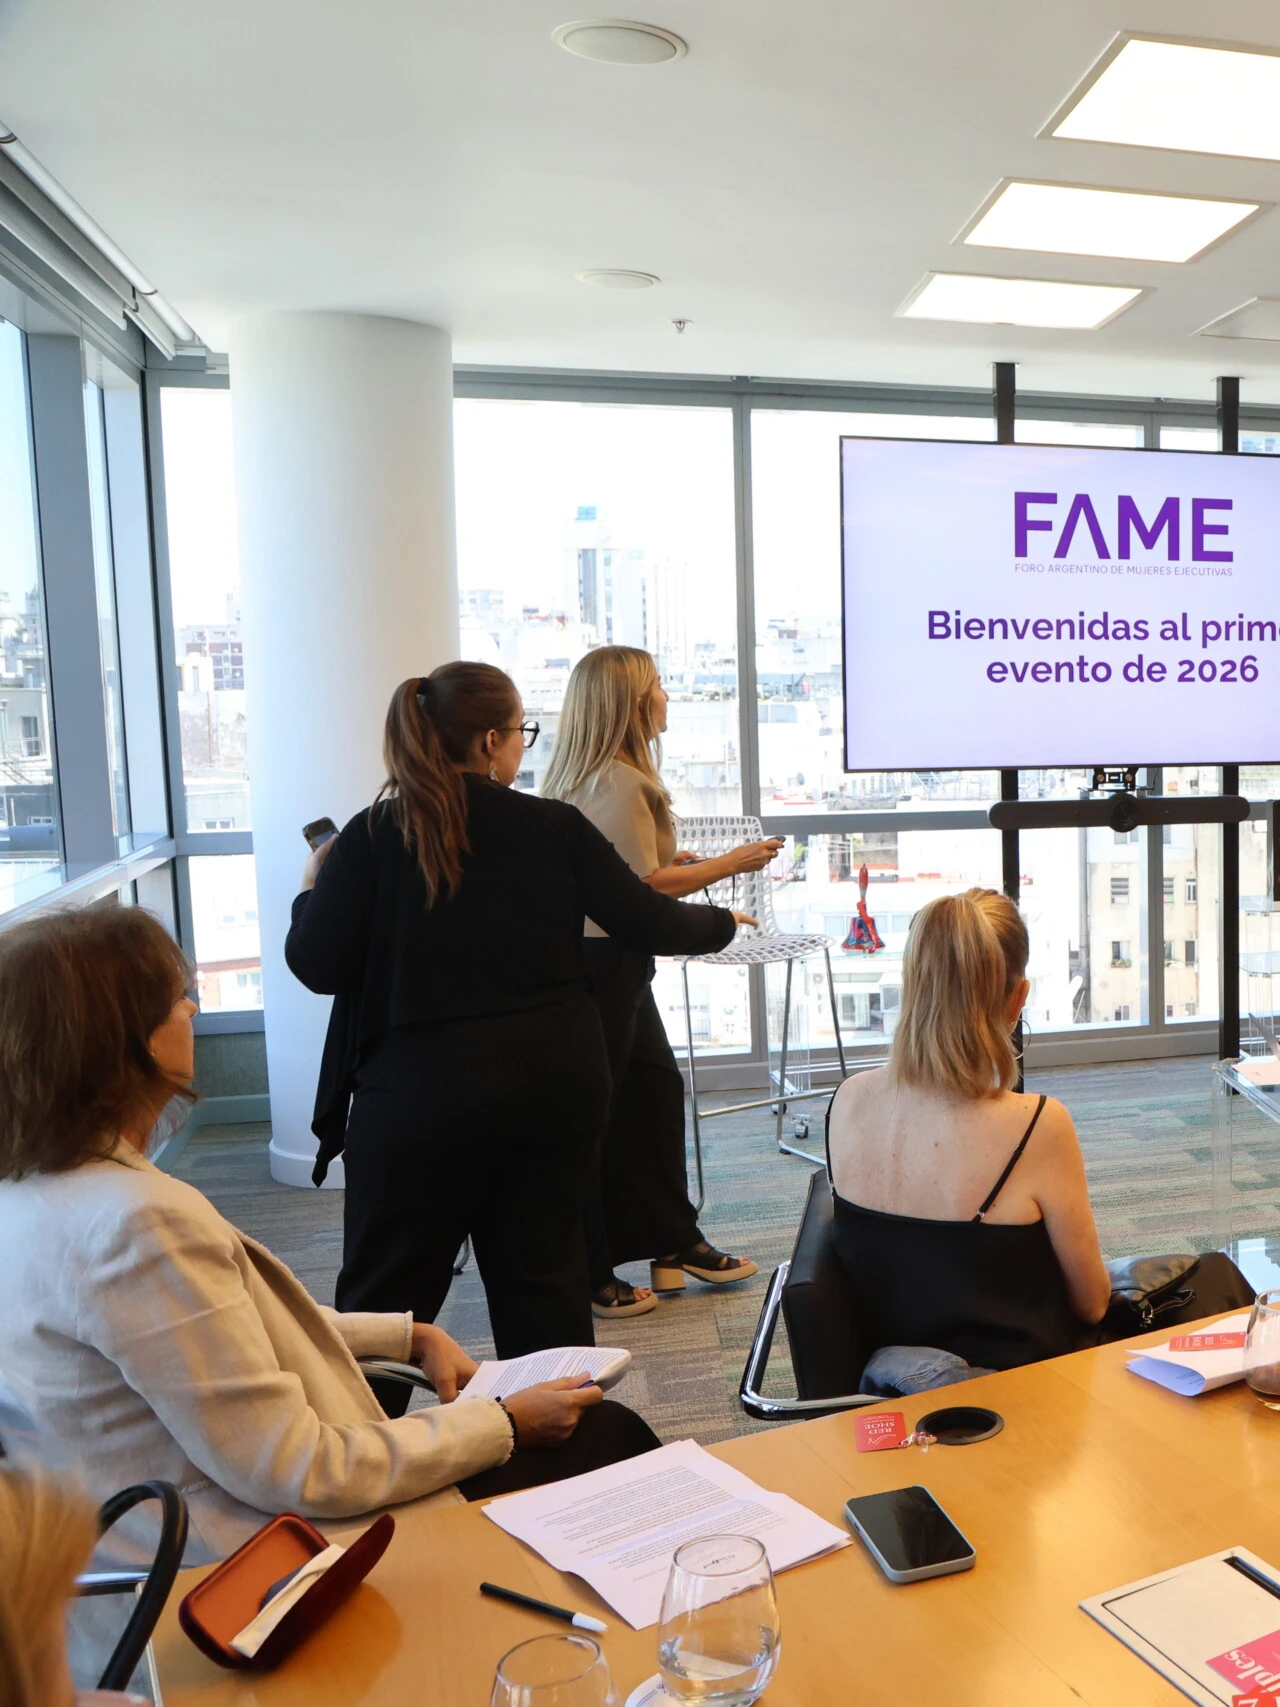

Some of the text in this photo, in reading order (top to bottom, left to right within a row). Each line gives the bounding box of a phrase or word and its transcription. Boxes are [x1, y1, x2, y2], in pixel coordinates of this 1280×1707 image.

[1014, 491, 1234, 563] FAME
[1014, 563, 1234, 577] FORO ARGENTINO DE MUJERES EJECUTIVAS
[927, 610, 1150, 641] Bienvenidas
[1159, 611, 1192, 641] al
[986, 653, 1259, 684] evento de 2026
[864, 1422, 895, 1430] SHOE
[868, 1427, 892, 1435] RED
